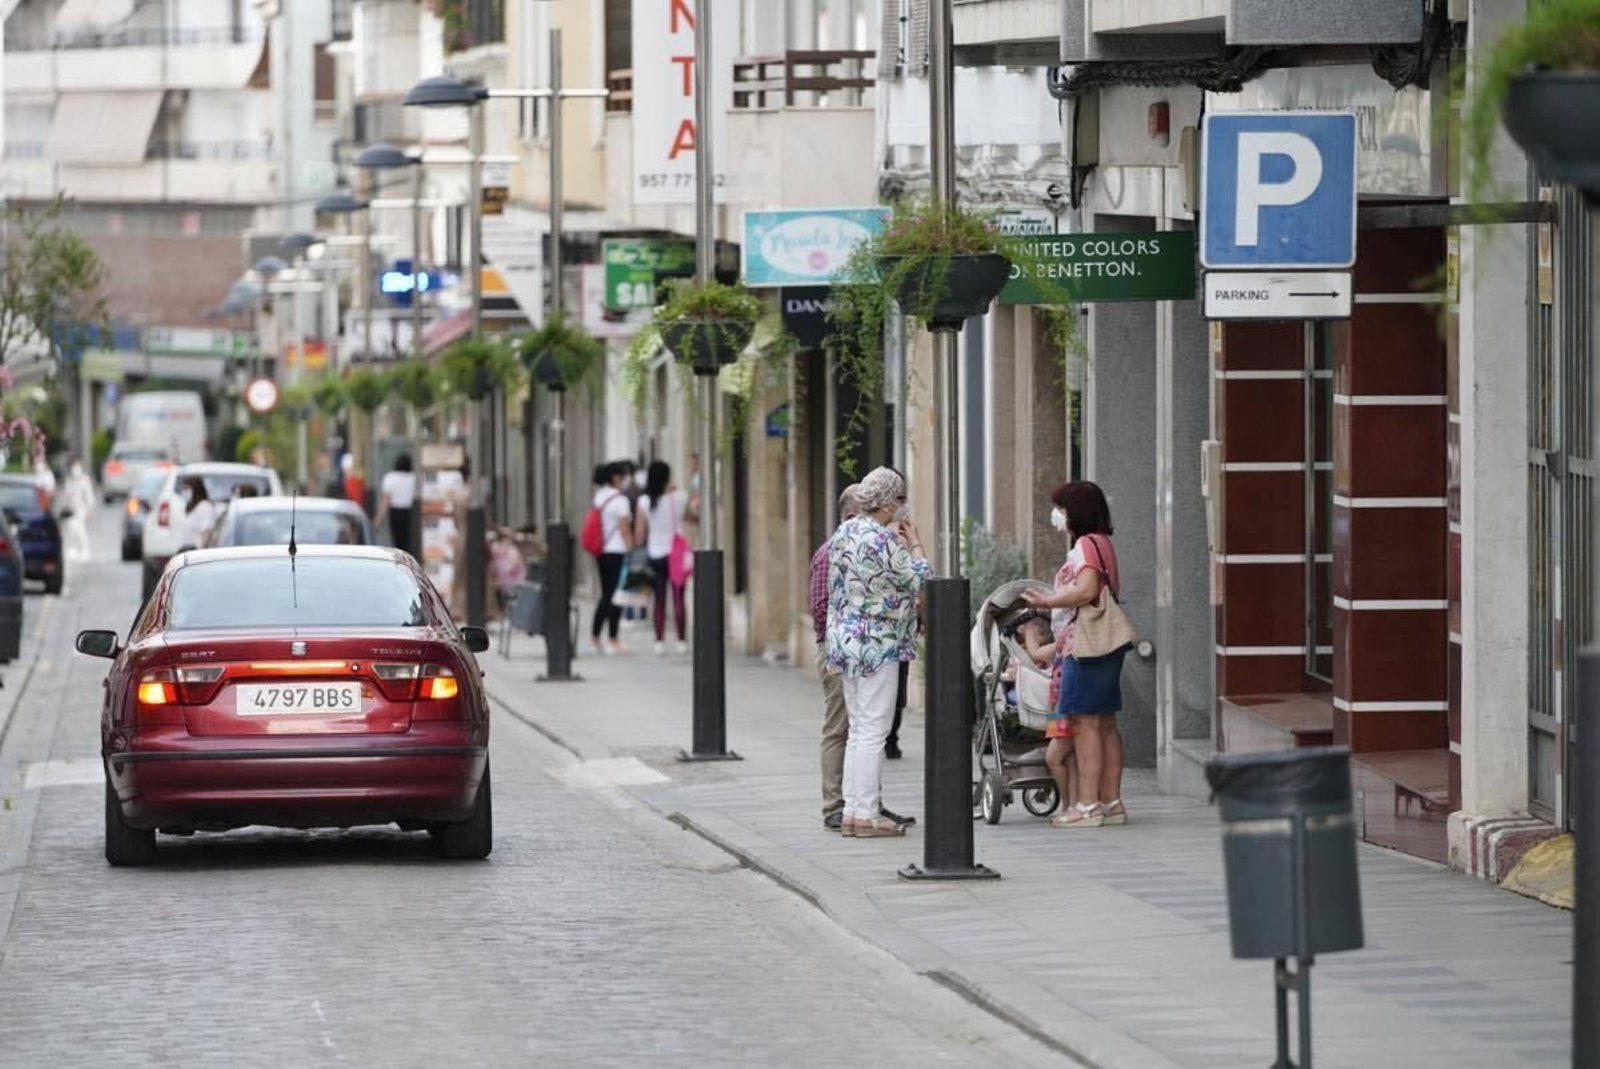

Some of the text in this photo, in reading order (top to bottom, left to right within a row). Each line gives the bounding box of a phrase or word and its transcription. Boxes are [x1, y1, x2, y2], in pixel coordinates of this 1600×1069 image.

[639, 173, 668, 188] 957
[1234, 131, 1323, 247] P
[1082, 240, 1160, 256] COLORS
[1215, 290, 1270, 301] PARKING
[180, 650, 217, 659] SEAT
[371, 647, 422, 656] TOLEDO
[254, 689, 353, 707] 4797 BBS
